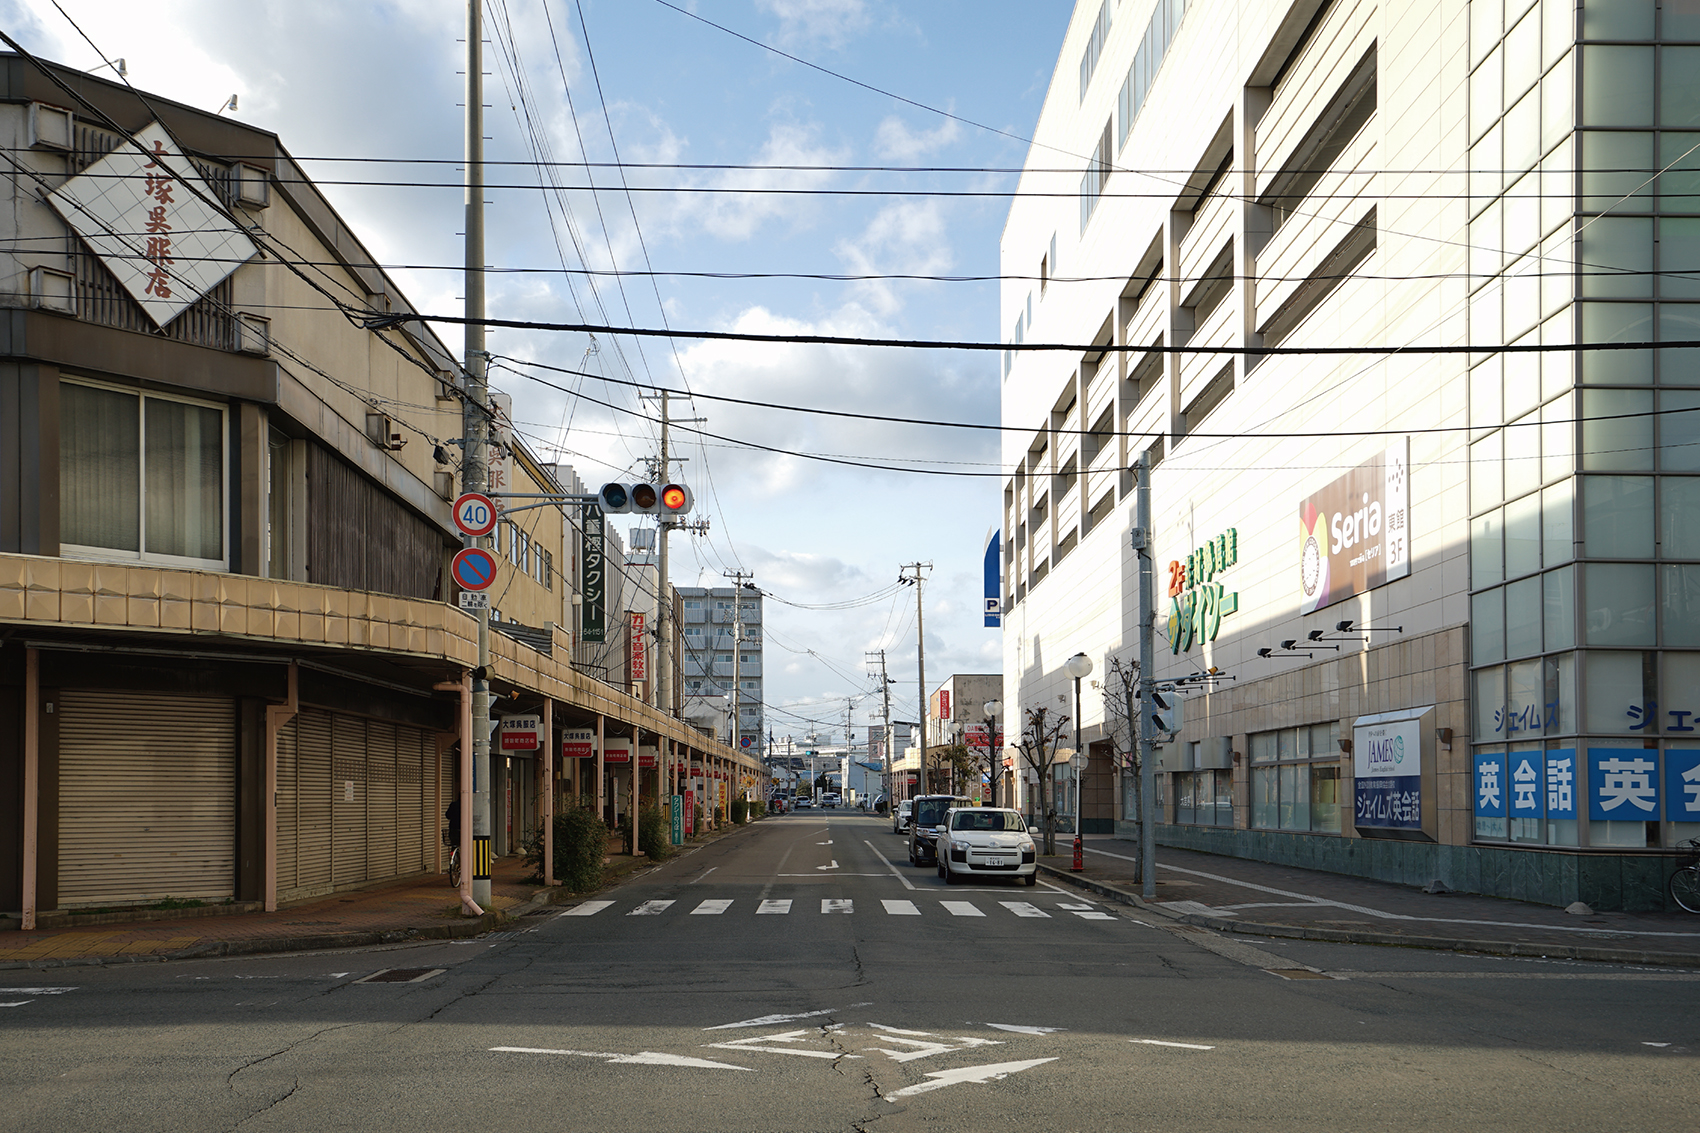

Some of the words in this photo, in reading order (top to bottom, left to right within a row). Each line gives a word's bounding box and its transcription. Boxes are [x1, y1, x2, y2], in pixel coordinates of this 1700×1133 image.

[462, 505, 487, 525] 40
[1331, 492, 1382, 555] Seria
[1388, 508, 1404, 533] 東館
[1390, 537, 1402, 565] 3F
[1168, 560, 1186, 598] 2F
[986, 600, 998, 610] P
[632, 615, 644, 679] カワイ音楽教室
[502, 720, 536, 729] 大塚呉服店
[1626, 701, 1700, 732] ジェ
[1367, 738, 1394, 769] JAMES
[1478, 757, 1573, 812] 英会話
[1357, 790, 1420, 822] ジェイムズ英会話
